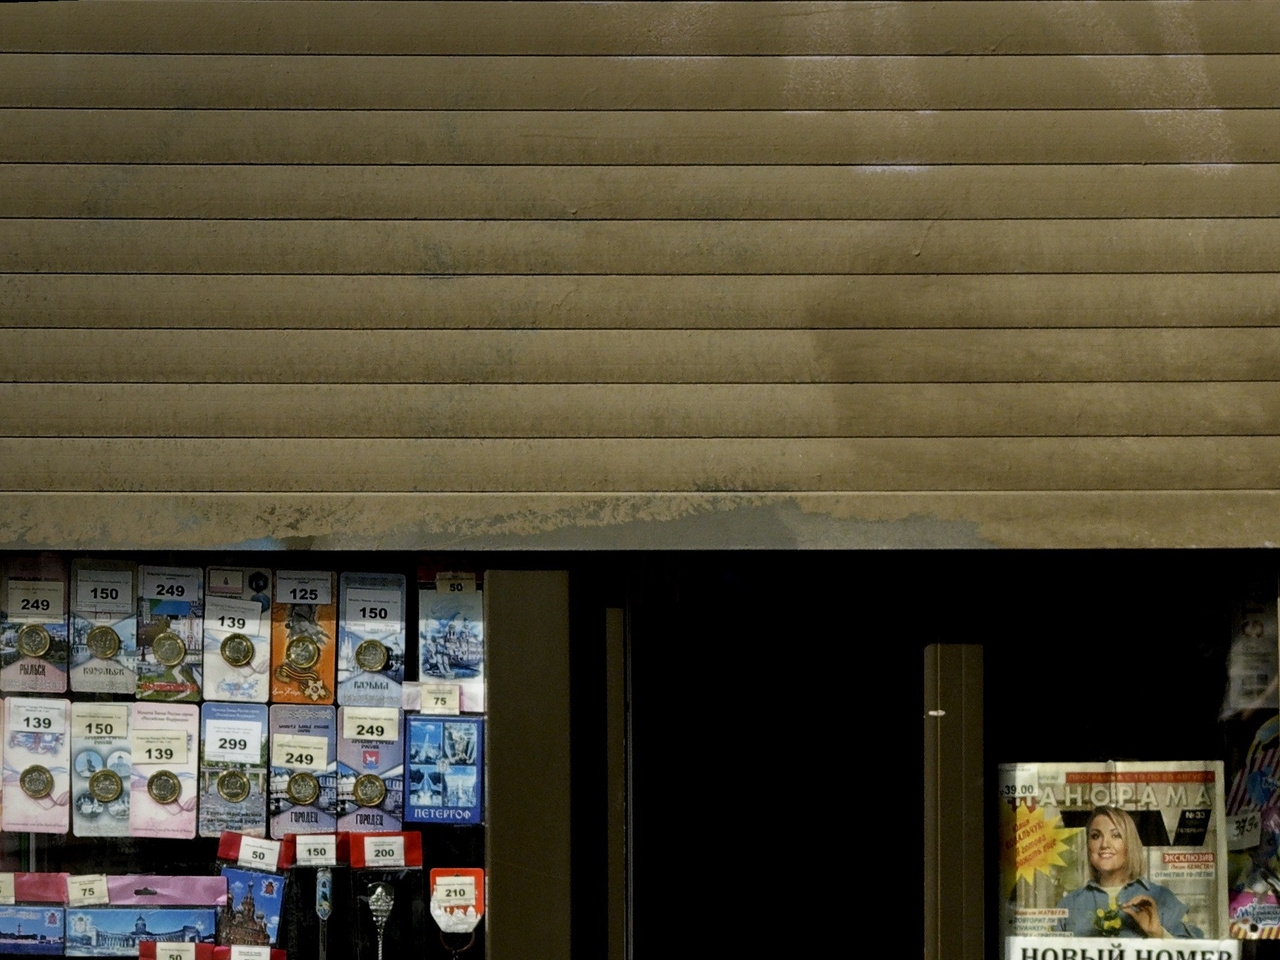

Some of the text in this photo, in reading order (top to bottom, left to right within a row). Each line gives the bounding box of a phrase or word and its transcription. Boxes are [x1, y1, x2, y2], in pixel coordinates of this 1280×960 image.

[90, 587, 119, 600] 150
[156, 584, 185, 597] 249
[449, 583, 463, 592] 50
[289, 588, 318, 600] 125
[21, 599, 50, 611] 249
[359, 607, 388, 619] 150
[217, 615, 246, 630] 139
[433, 697, 447, 706] 75
[23, 717, 52, 729] 139
[85, 723, 114, 735] 150
[356, 725, 385, 737] 249
[218, 738, 247, 750] 299
[145, 748, 174, 760] 139
[285, 752, 314, 765] 249
[1004, 784, 1034, 796] 39.00
[414, 807, 472, 820] ПЕТЕРГОФ
[251, 850, 265, 861] 50
[306, 847, 327, 857] 150
[374, 848, 395, 858] 200
[1163, 852, 1215, 863] ЭКСКЛЮЗИВ
[81, 888, 95, 897] 75
[445, 887, 467, 898] 210
